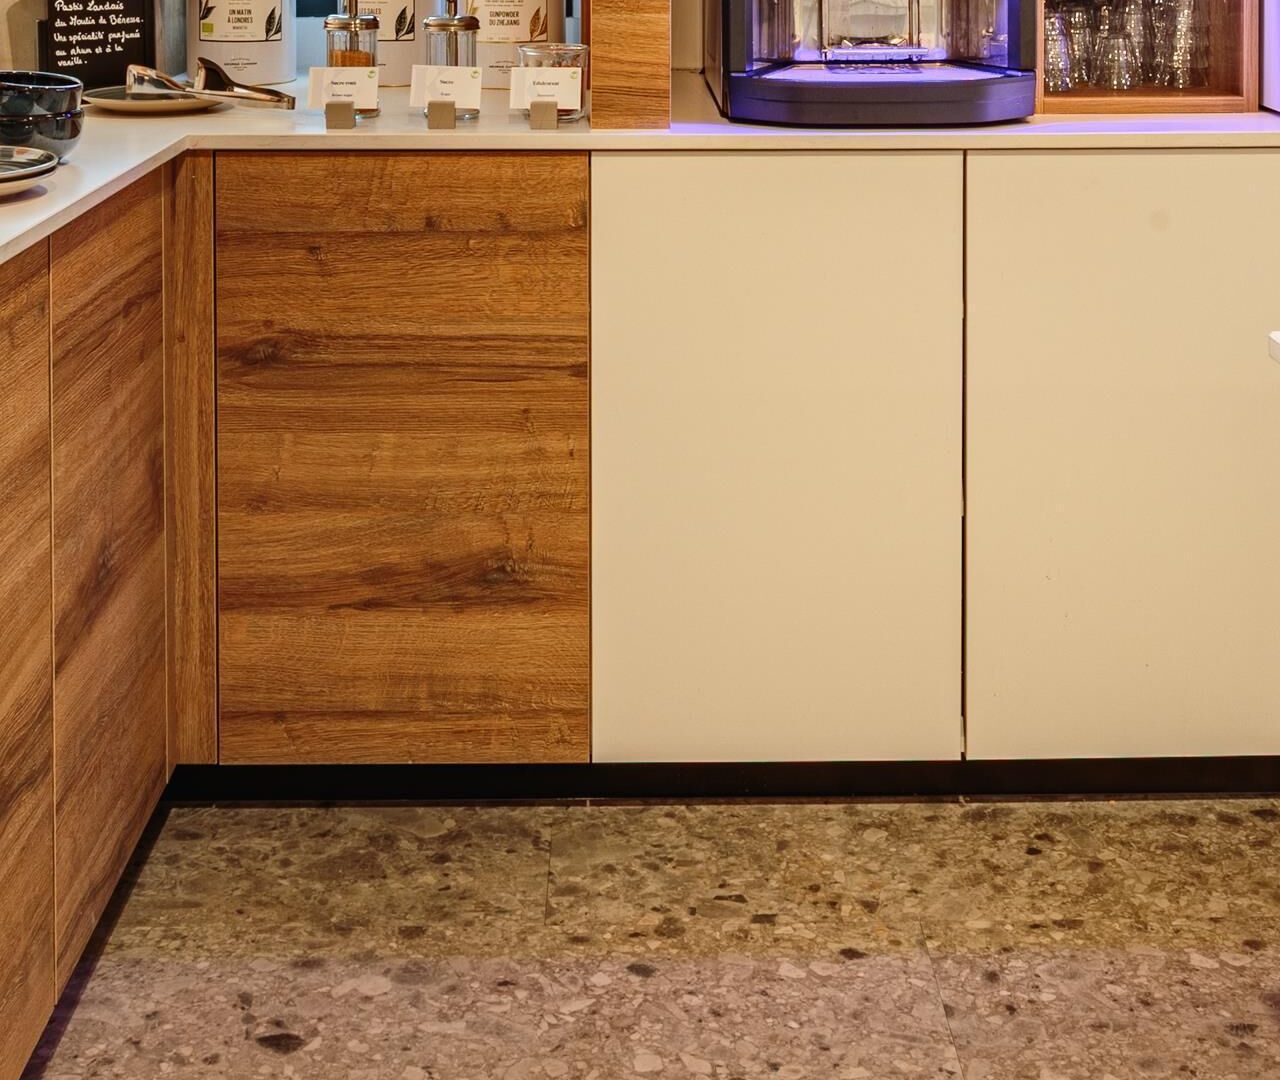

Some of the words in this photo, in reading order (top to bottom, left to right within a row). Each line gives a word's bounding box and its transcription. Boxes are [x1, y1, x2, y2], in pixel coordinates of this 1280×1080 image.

[54, 0, 84, 12] Pastis
[86, 0, 124, 12] Landais
[55, 18, 67, 28] du
[69, 15, 96, 26] Moulin
[53, 32, 67, 41] Une
